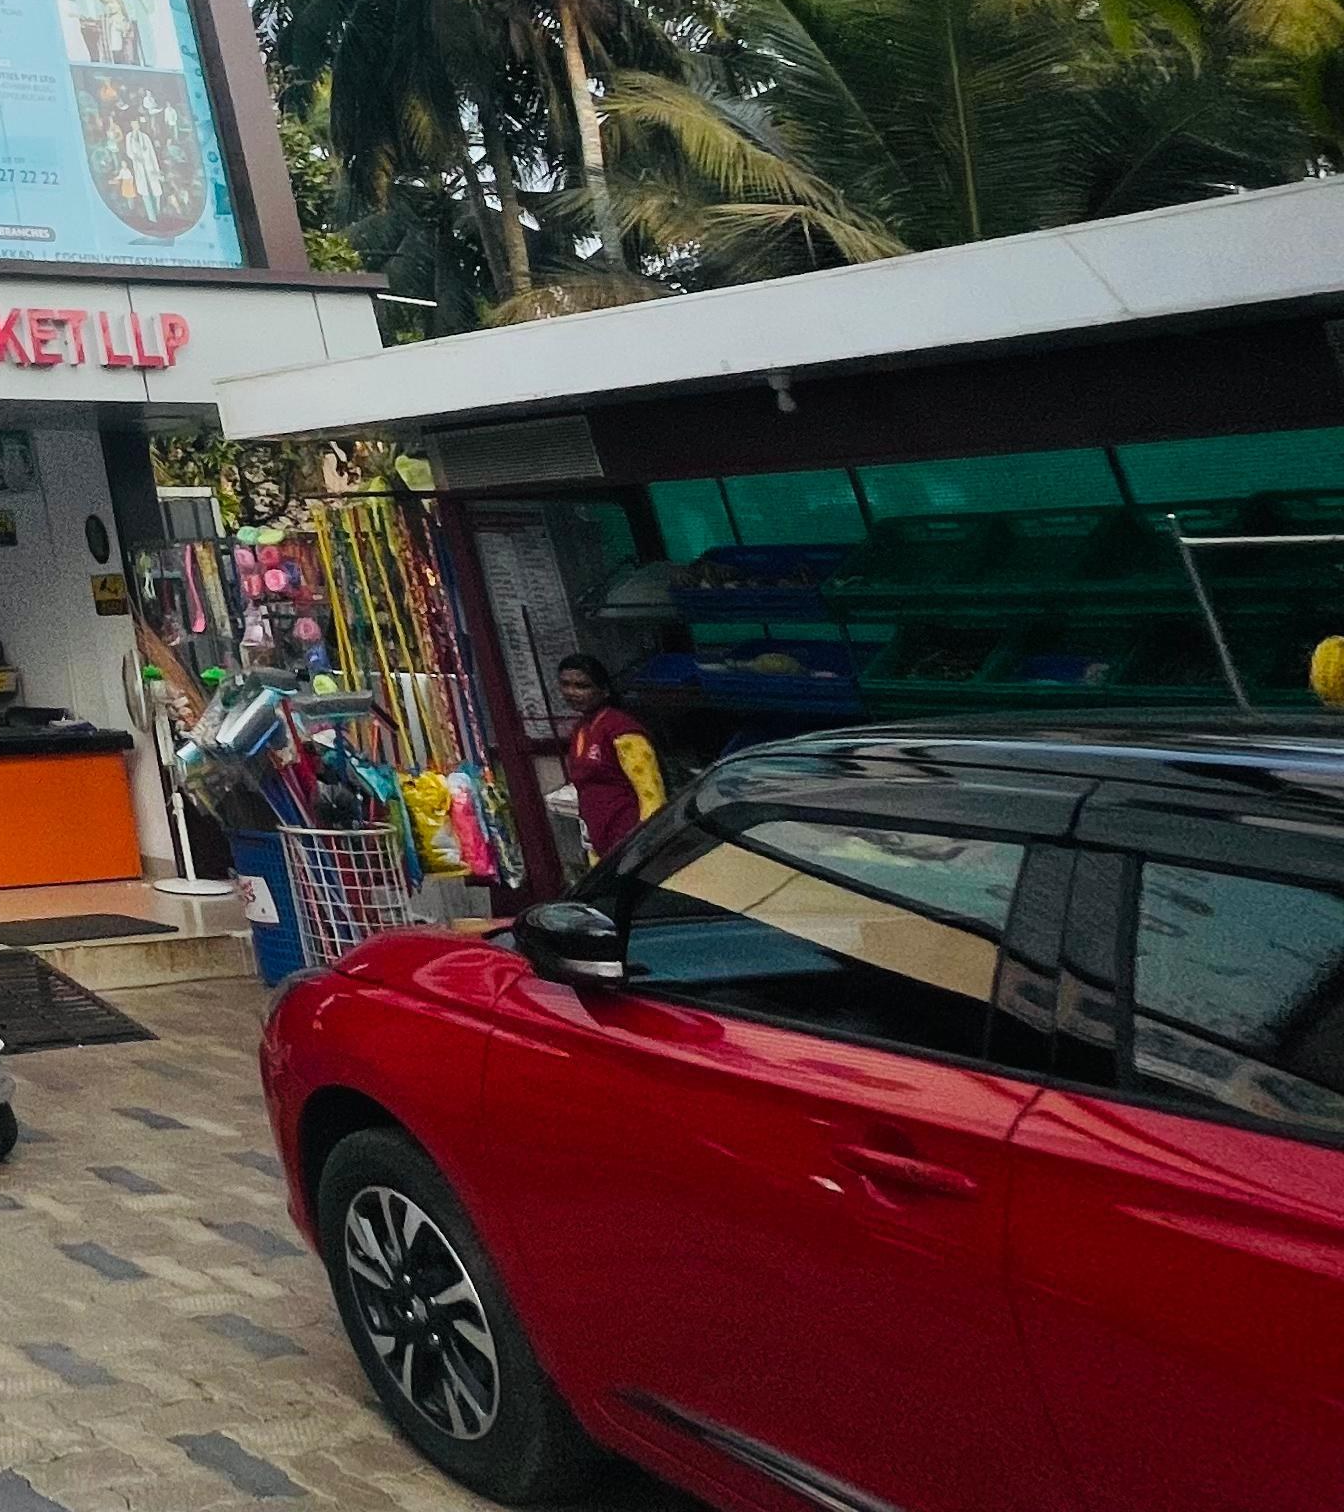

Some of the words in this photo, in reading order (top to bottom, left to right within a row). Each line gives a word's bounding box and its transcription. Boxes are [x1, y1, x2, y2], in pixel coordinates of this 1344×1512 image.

[20, 170, 37, 185] 22
[41, 171, 59, 186] 22
[96, 310, 191, 370] LLP
